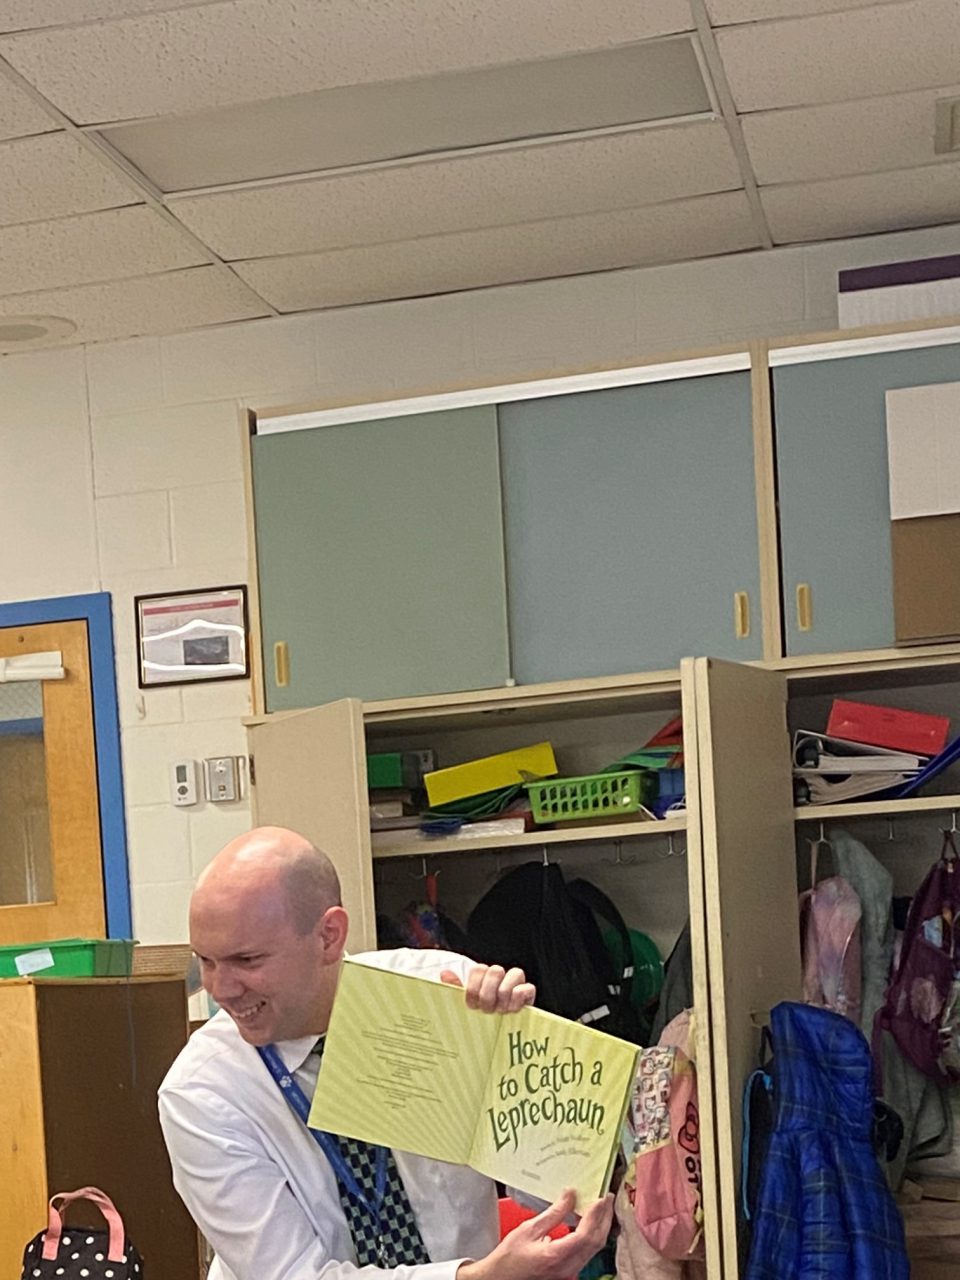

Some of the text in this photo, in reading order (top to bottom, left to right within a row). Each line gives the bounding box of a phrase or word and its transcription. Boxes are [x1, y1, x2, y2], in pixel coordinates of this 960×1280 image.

[497, 1046, 603, 1101] to Catch a
[508, 1030, 550, 1069] How
[486, 1089, 606, 1153] Leprechaun
